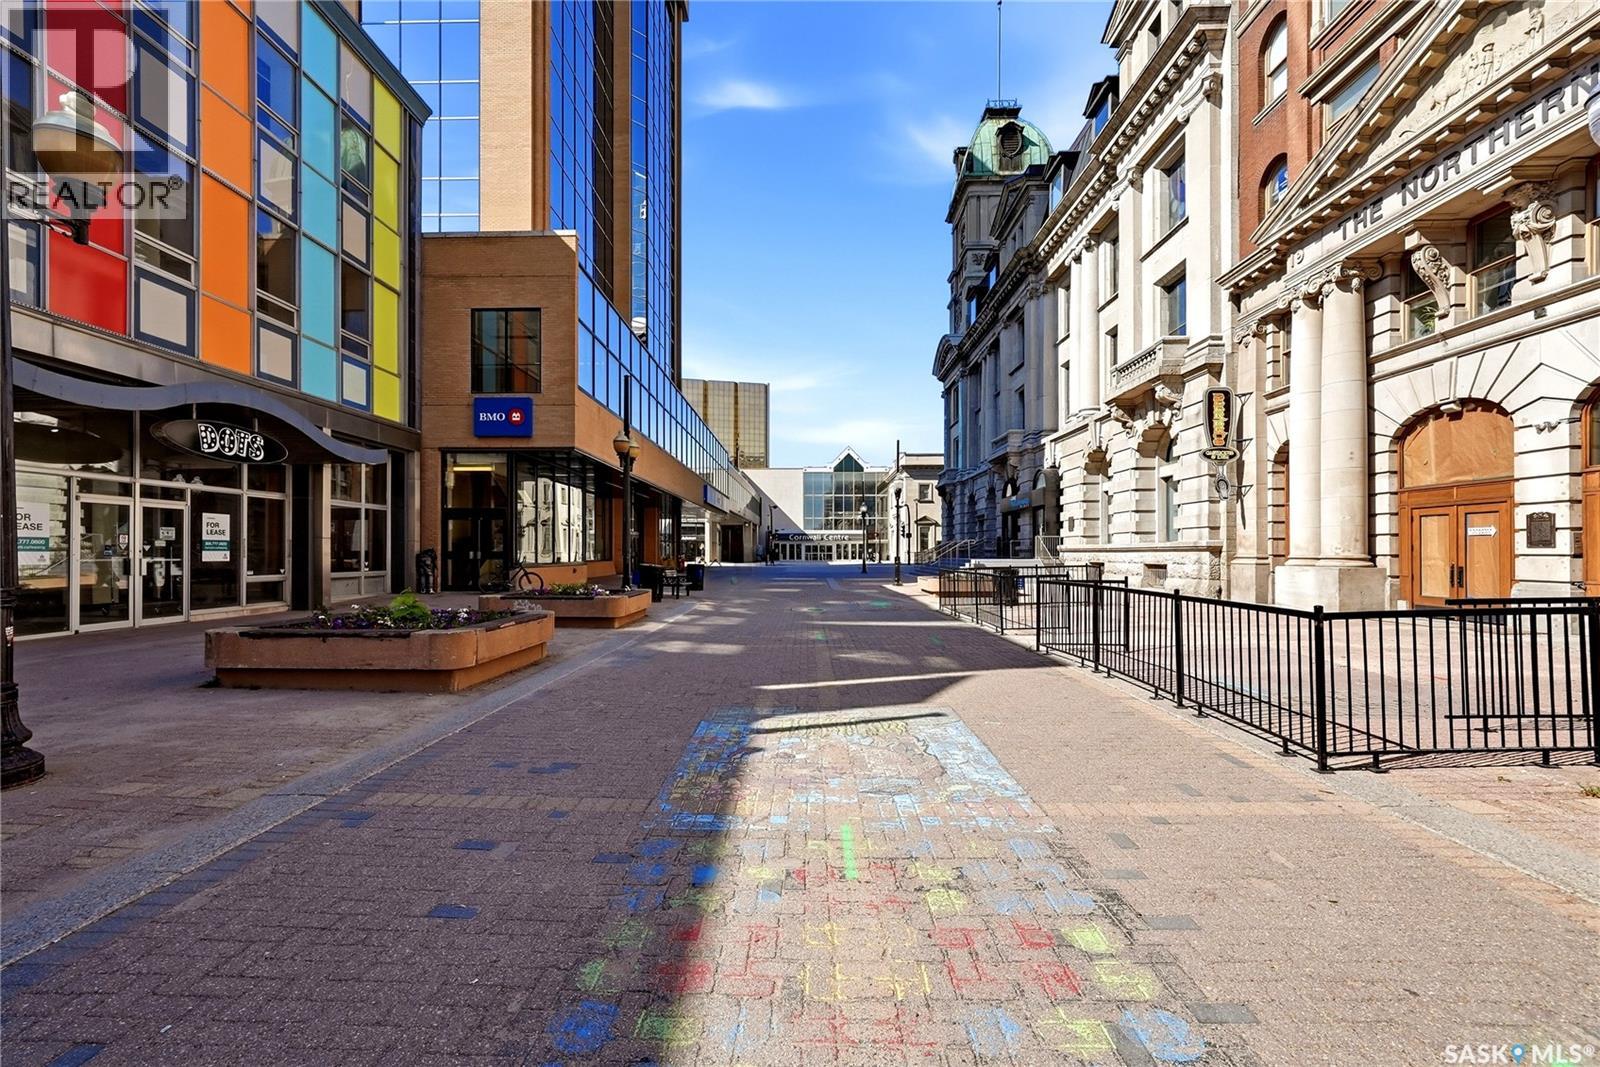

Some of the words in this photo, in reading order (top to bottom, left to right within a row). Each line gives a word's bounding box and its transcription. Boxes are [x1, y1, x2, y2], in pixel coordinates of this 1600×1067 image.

[1338, 196, 1385, 241] THE
[1400, 62, 1600, 207] NORTHERN
[479, 412, 506, 421] BMO
[198, 424, 264, 461] DOTS
[16, 512, 31, 521] OR
[16, 522, 43, 531] EASE
[788, 533, 822, 541] Cornwall
[823, 533, 850, 541] Centre
